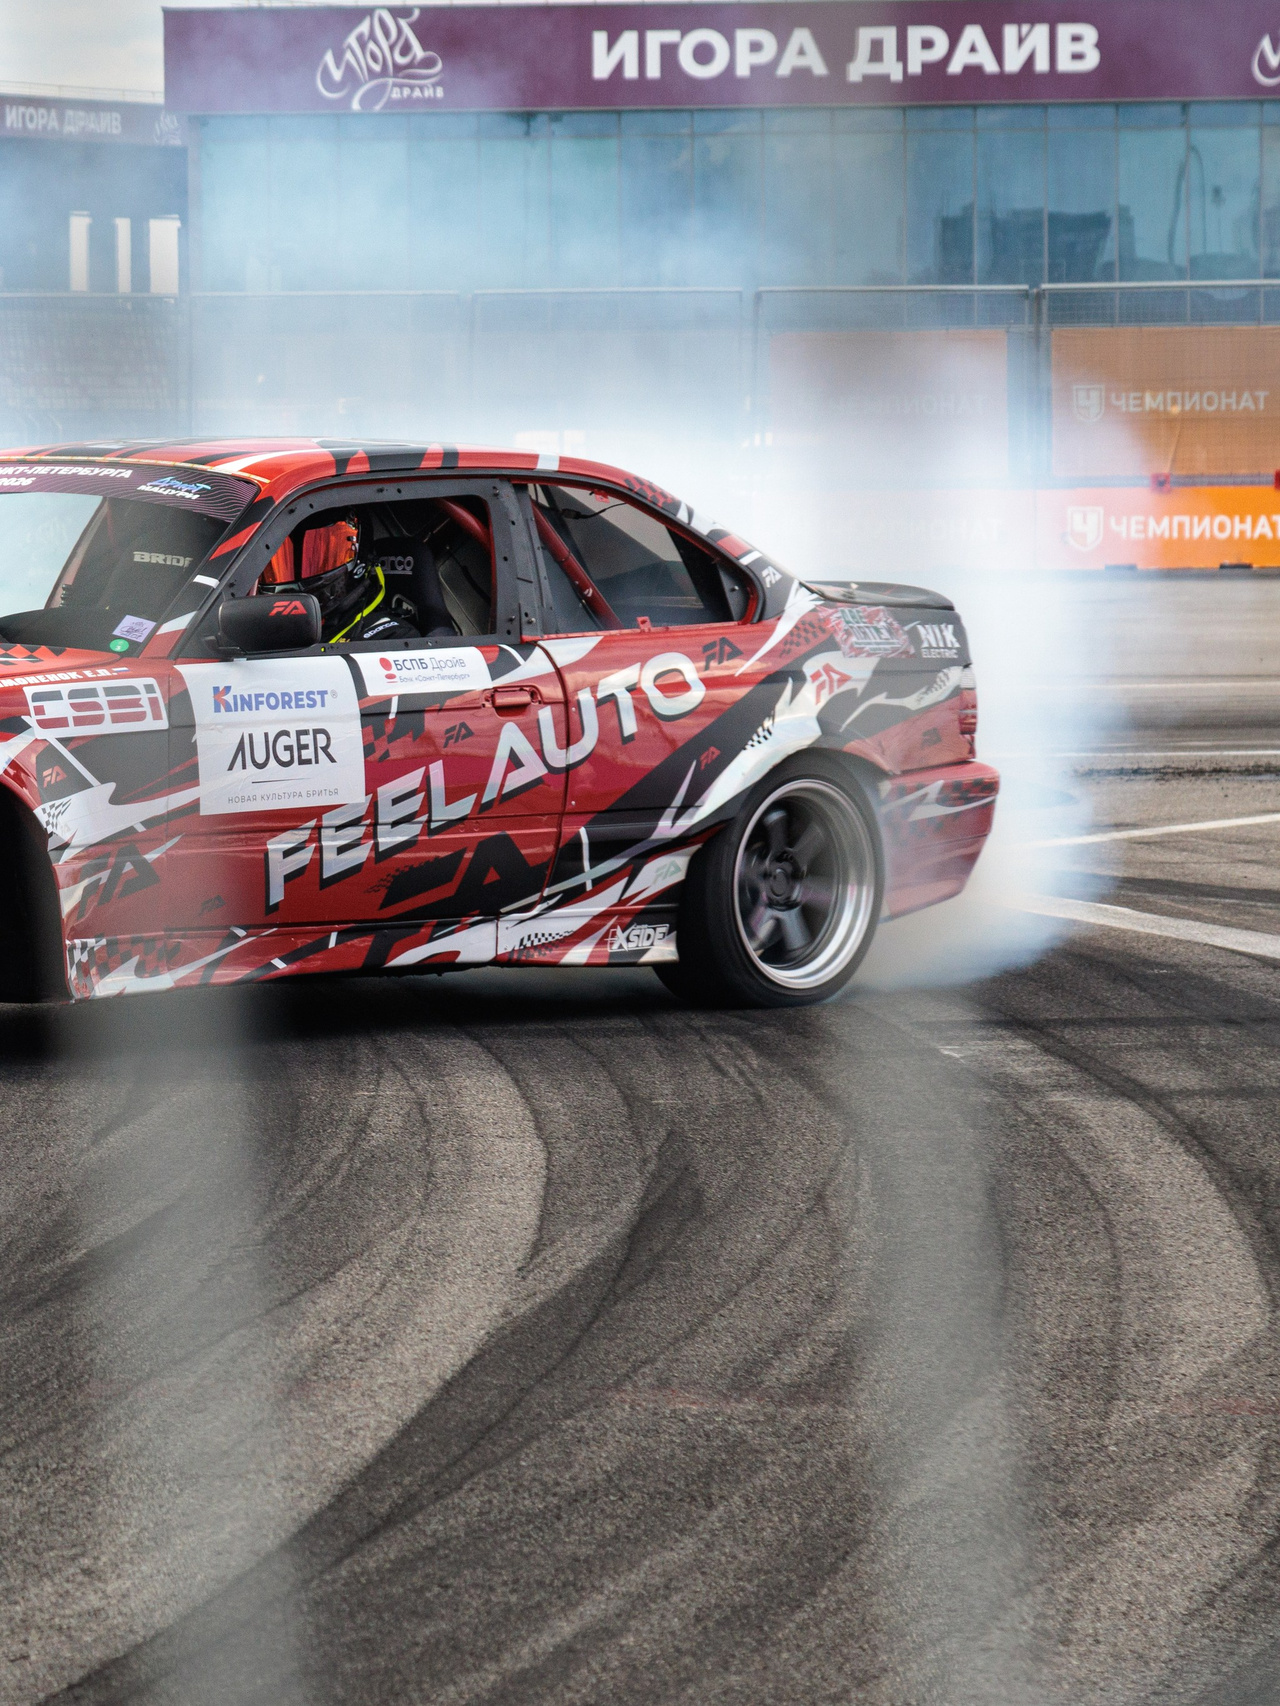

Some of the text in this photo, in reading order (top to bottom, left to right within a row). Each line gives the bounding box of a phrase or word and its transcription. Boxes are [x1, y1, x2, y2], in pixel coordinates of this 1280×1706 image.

[592, 22, 1101, 82] ИГОРА ДРАЙВ
[389, 85, 444, 98] ДРАЙВ
[5, 104, 59, 131] ИГОРА
[1110, 391, 1270, 412] ЧЕМПИОНАТ
[268, 600, 308, 617] FA
[363, 621, 399, 639] sparco
[917, 623, 962, 648] NIK
[922, 648, 959, 659] ELECTRIC
[393, 657, 467, 672] БСПБ Драйв
[399, 675, 414, 683] Банк
[227, 727, 338, 771] AUGER
[227, 787, 340, 805] НОВАЯ КУЛЬТУРА БРИТЬЯ
